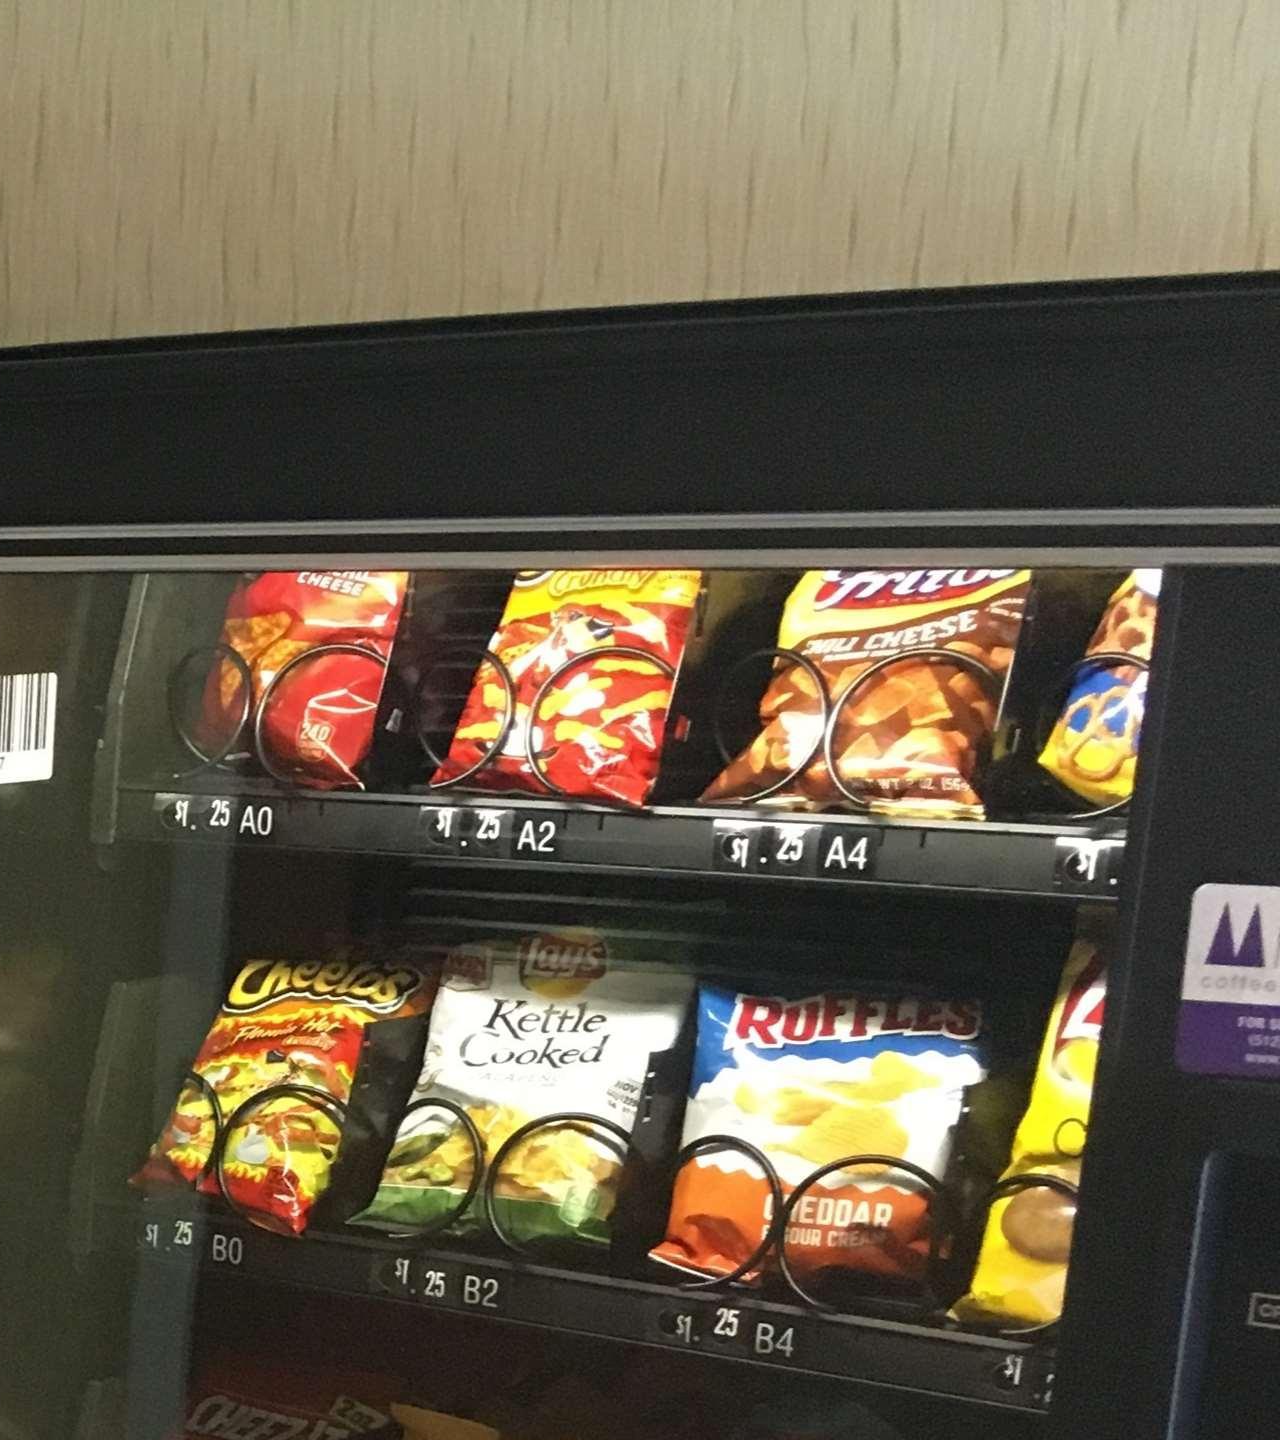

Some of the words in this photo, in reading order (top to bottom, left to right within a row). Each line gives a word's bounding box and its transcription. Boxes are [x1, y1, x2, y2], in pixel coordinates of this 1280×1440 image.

[297, 572, 366, 597] CHEESE
[864, 609, 980, 650] CHEESE
[240, 806, 273, 836] A0
[517, 820, 556, 853] A2
[824, 836, 868, 871] A4
[483, 998, 608, 1042] Kettle
[734, 994, 980, 1048] RUFFLES
[459, 1031, 611, 1069] Cooked
[212, 1233, 243, 1265] B0
[464, 1274, 499, 1308] B2
[754, 1322, 794, 1358] B4
